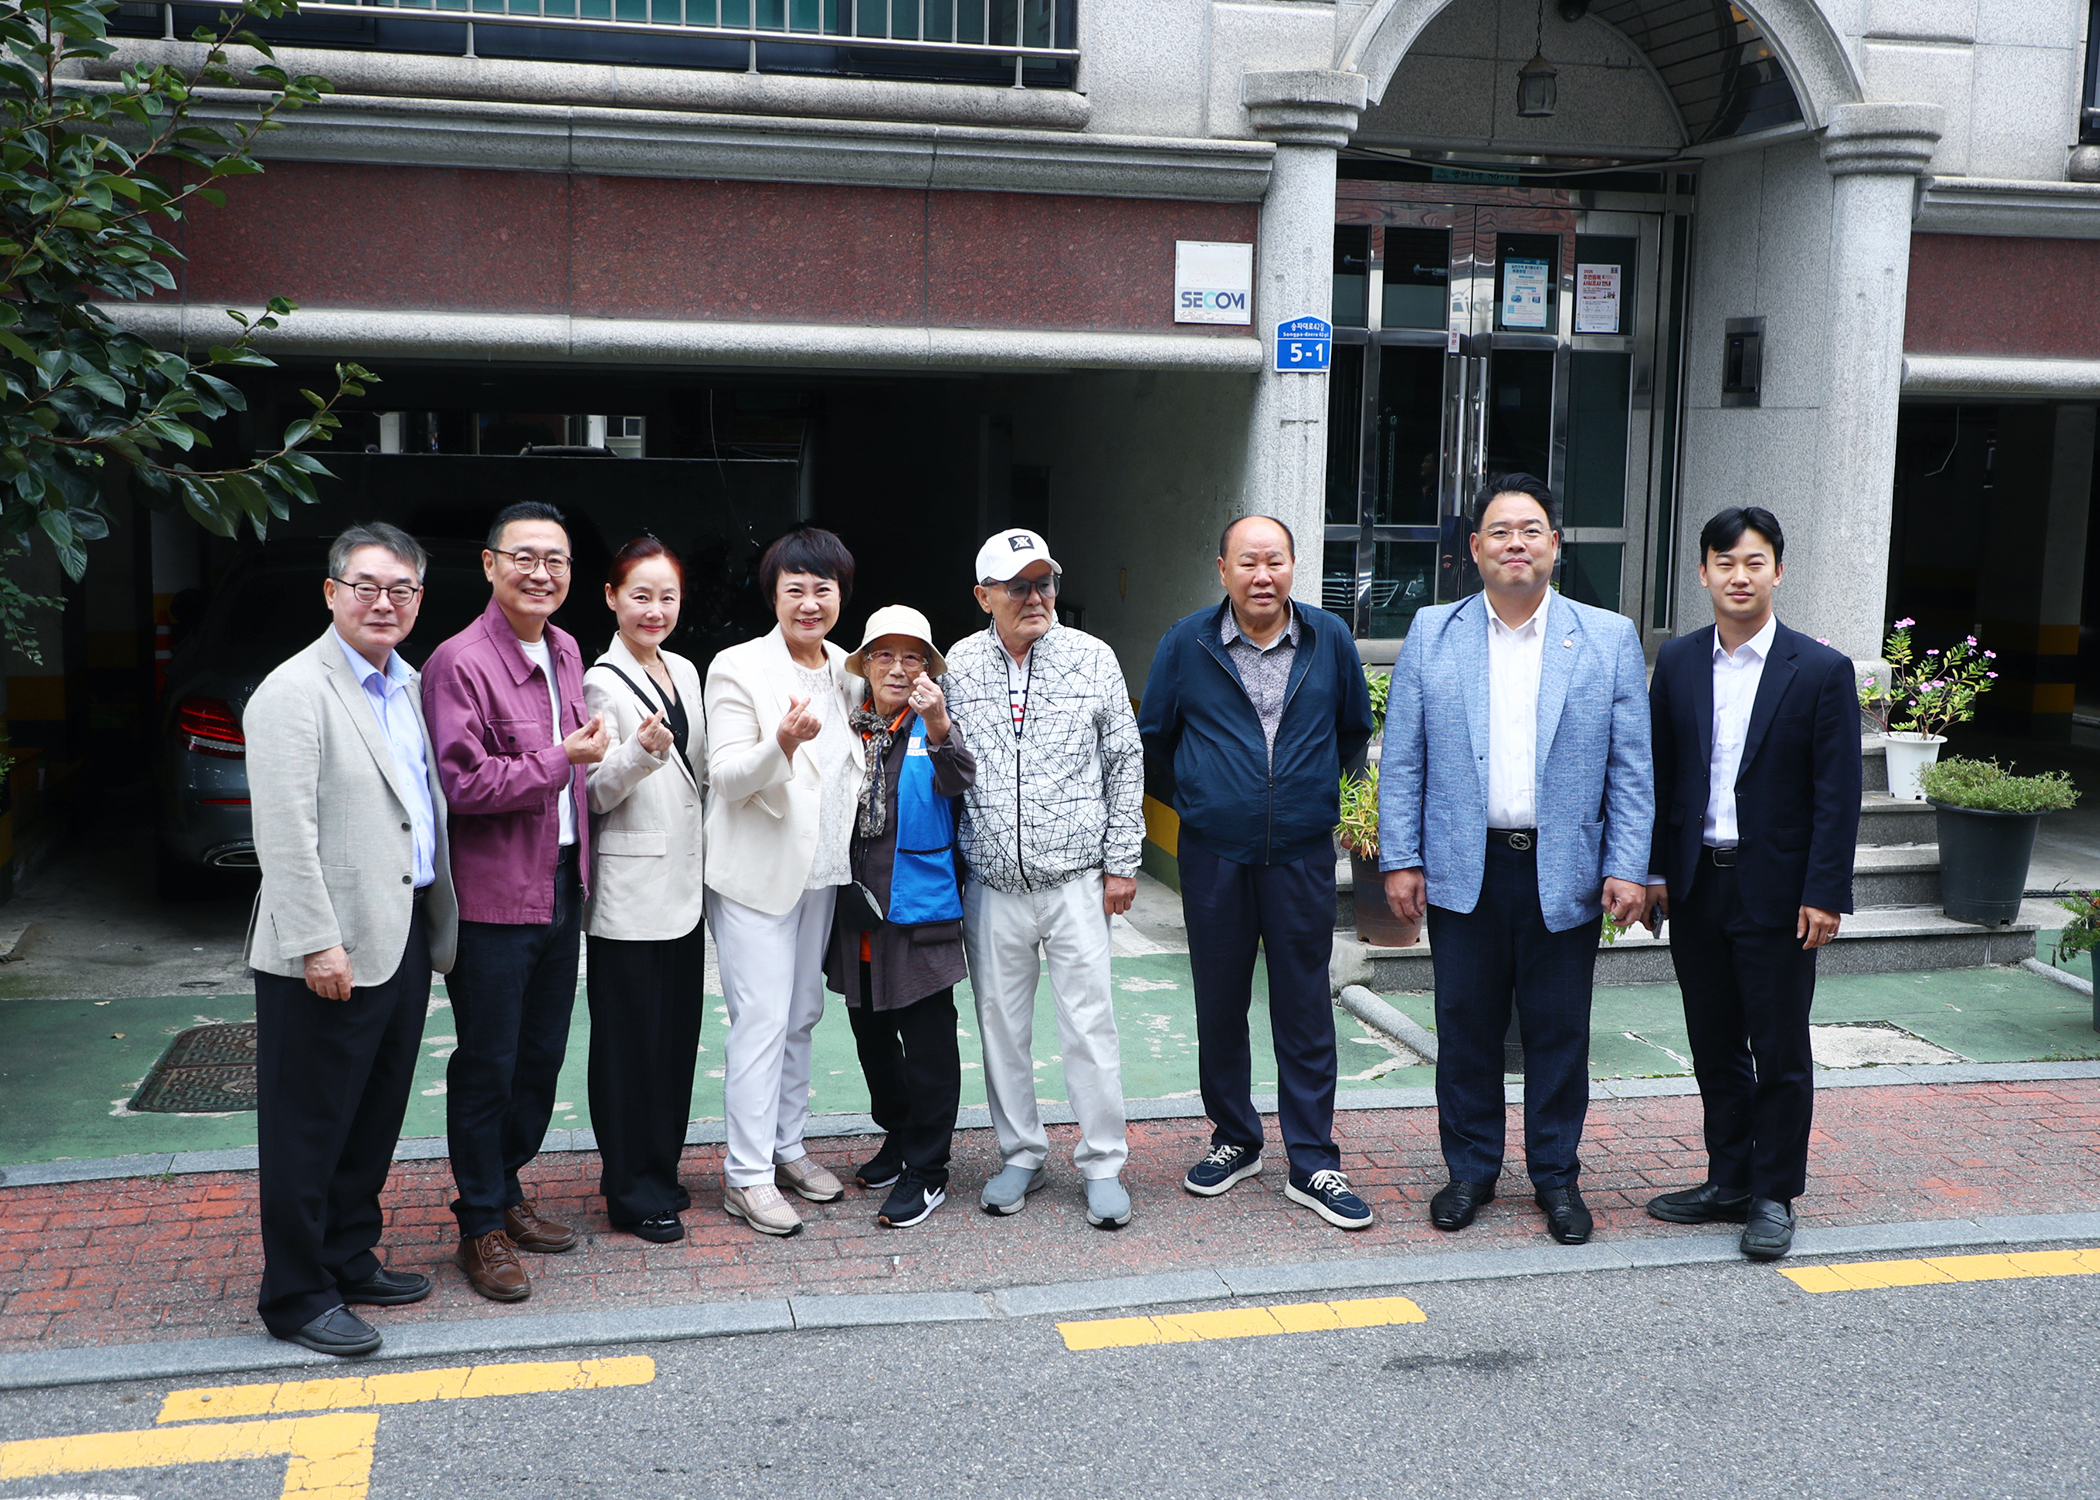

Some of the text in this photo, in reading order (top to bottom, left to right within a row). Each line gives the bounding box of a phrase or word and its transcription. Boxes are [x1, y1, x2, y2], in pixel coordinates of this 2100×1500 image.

[1181, 291, 1245, 309] SECOM
[1291, 322, 1325, 331] 송파대로42길
[1290, 343, 1323, 362] 5-1
